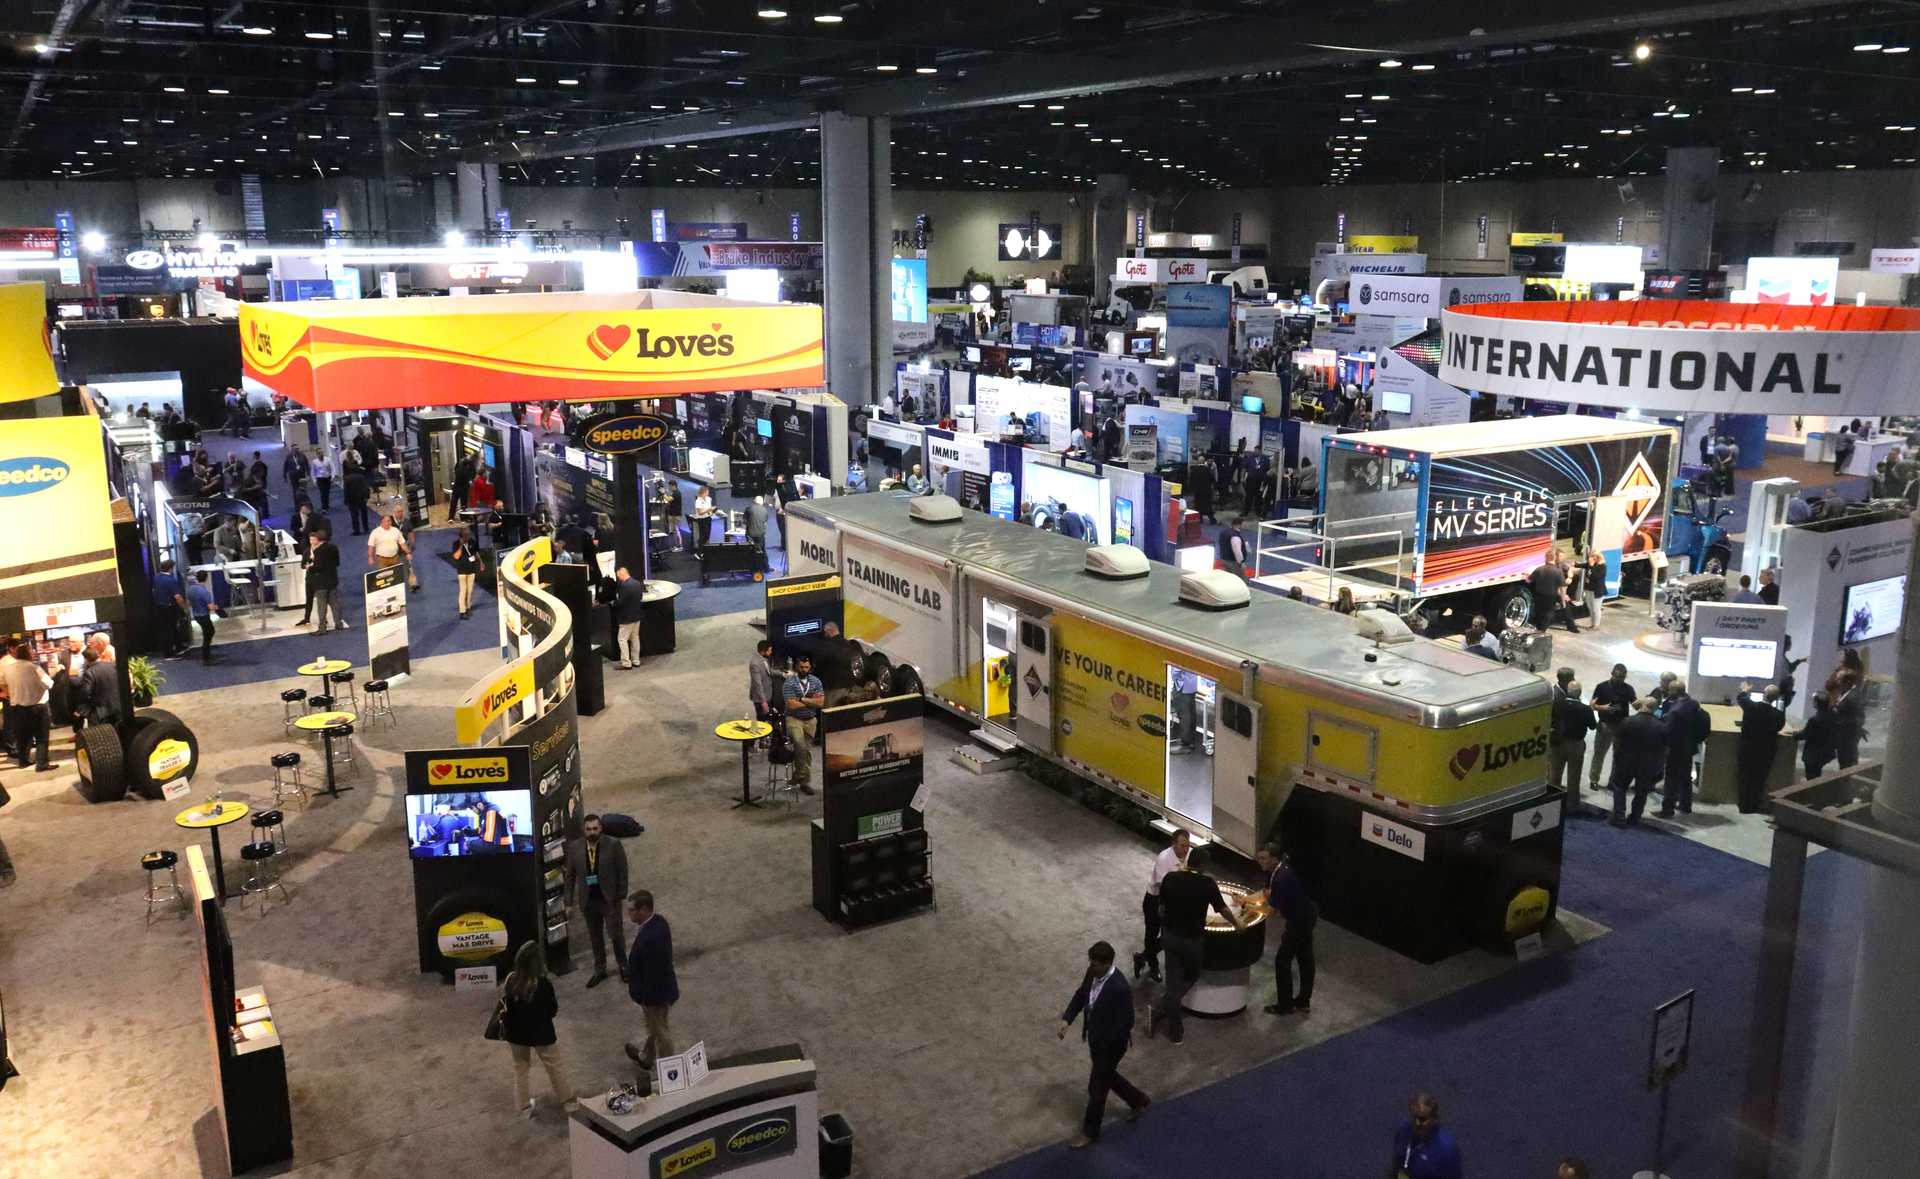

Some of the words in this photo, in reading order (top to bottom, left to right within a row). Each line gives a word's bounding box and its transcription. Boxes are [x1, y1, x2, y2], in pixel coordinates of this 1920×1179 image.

[1149, 237, 1165, 247] EXIT
[1192, 237, 1210, 247] EXIT
[166, 251, 257, 267] HYUNDAI
[719, 248, 749, 267] Brake
[752, 249, 809, 270] Industry
[168, 267, 240, 278] TRANSLEAD
[1125, 260, 1148, 280] Grote
[1168, 260, 1195, 280] Grote
[1349, 265, 1406, 273] MICHELIN
[1649, 280, 1677, 289] WEBB
[1373, 290, 1430, 304] samsara
[1462, 292, 1511, 304] samsara
[1446, 329, 1842, 395] INTERNATIONAL
[591, 424, 662, 446] speedco
[171, 501, 210, 509] GEOTAB
[1435, 487, 1549, 514] ELECTRIC
[1432, 513, 1471, 541] MV
[1473, 502, 1548, 535] SERIES
[787, 584, 812, 593] CONNECT
[846, 557, 911, 599] TRAINING
[913, 584, 942, 611] LAB
[505, 588, 536, 616] NATIONWIDE
[1740, 616, 1767, 624] PARTS
[1073, 652, 1113, 682] YOUR
[531, 720, 571, 761] Services
[839, 768, 859, 778] BATTERY
[872, 812, 902, 827] POWER
[1387, 827, 1413, 850] Delo
[452, 941, 470, 949] MAX
[471, 939, 495, 947] DRIVE
[455, 932, 490, 942] VANTAGE
[731, 1123, 788, 1150] speedco
